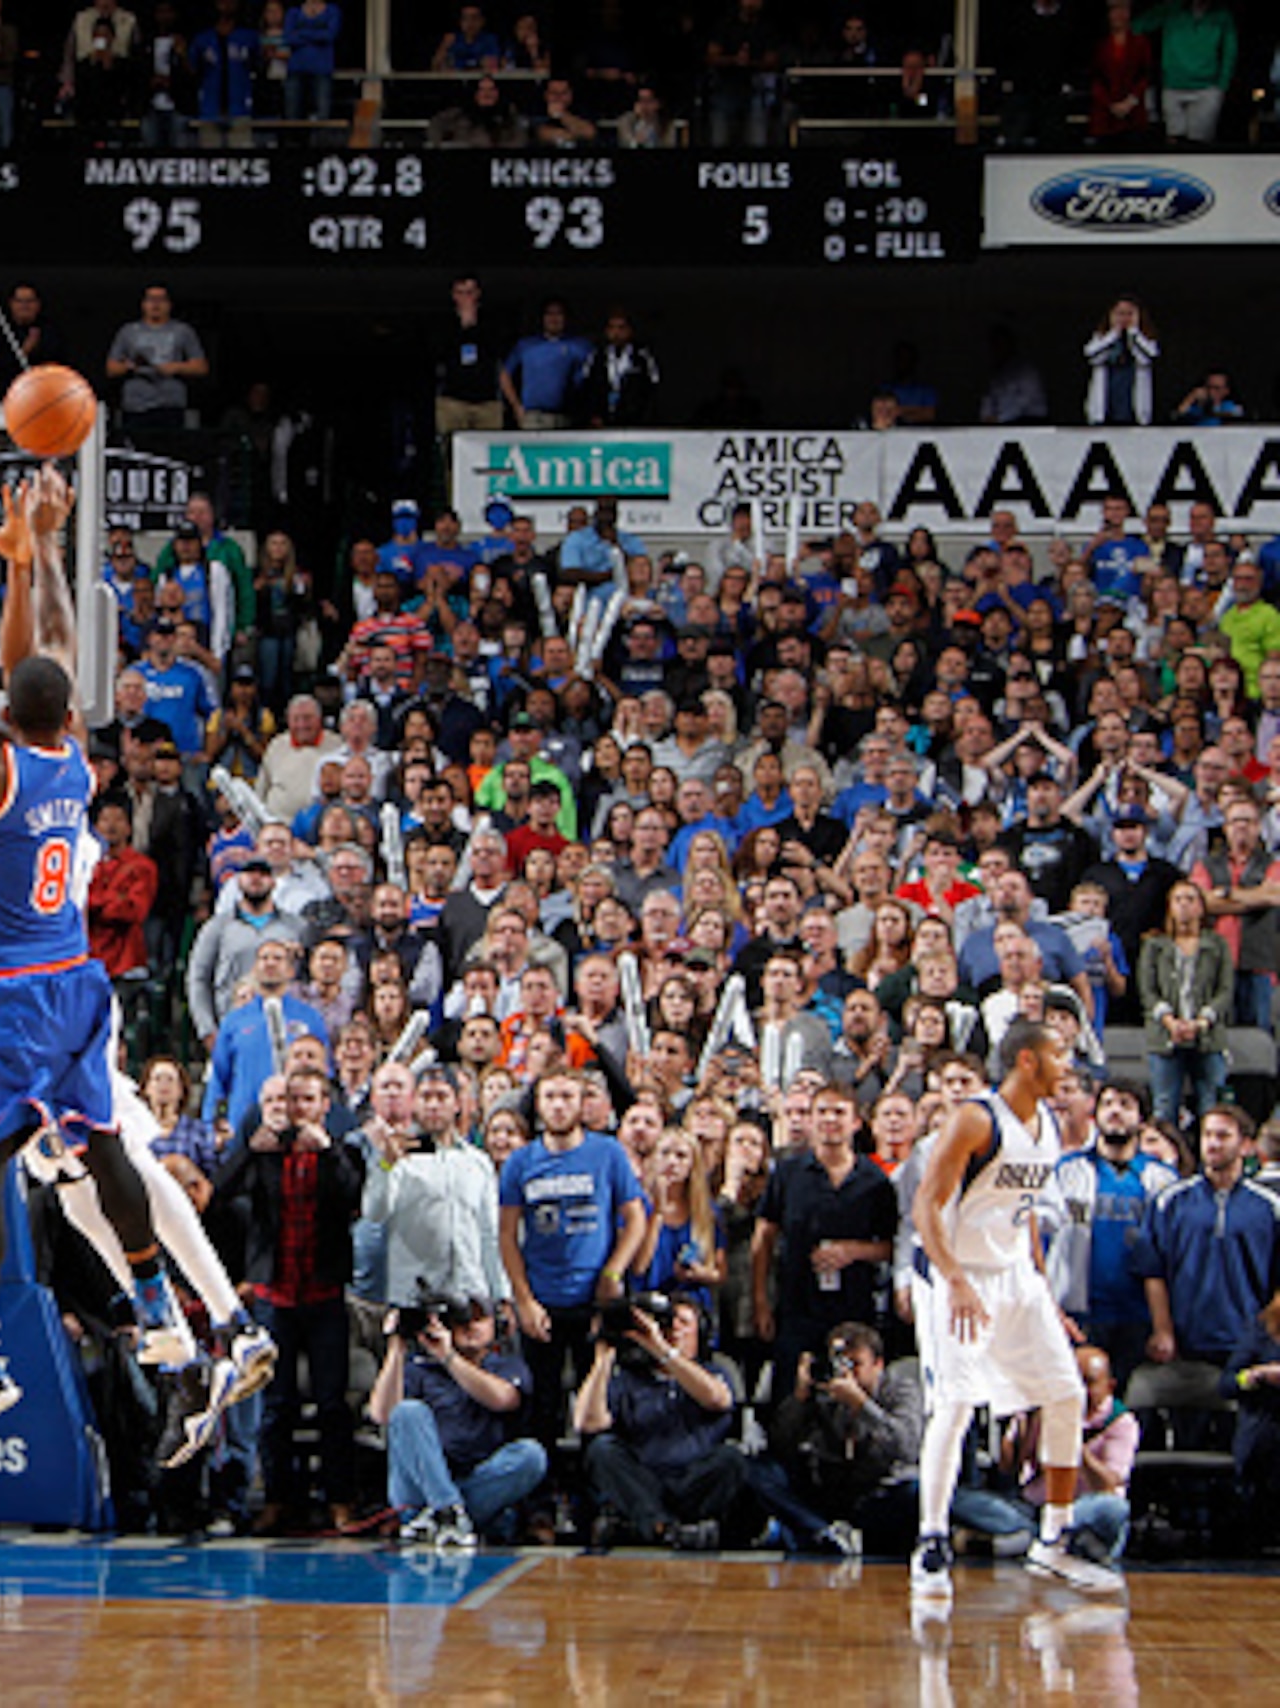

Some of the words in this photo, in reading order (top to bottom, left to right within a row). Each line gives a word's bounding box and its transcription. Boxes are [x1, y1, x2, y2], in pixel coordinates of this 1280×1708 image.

[84, 157, 270, 186] MAVERICKS
[302, 156, 423, 196] :02.8
[490, 157, 615, 188] KNICKS
[698, 161, 791, 188] FOULS
[842, 160, 900, 188] TOL
[1066, 175, 1179, 222] Ford
[122, 198, 203, 251] 95
[308, 216, 384, 250] QTR
[404, 217, 427, 249] 4
[524, 196, 605, 249] 93
[742, 205, 770, 245] 5
[875, 232, 946, 259] FULL
[713, 436, 845, 463] AMICA
[497, 445, 664, 490] Amica
[716, 466, 844, 497] ASSIST
[25, 798, 84, 835] SMIT
[30, 836, 70, 915] 8
